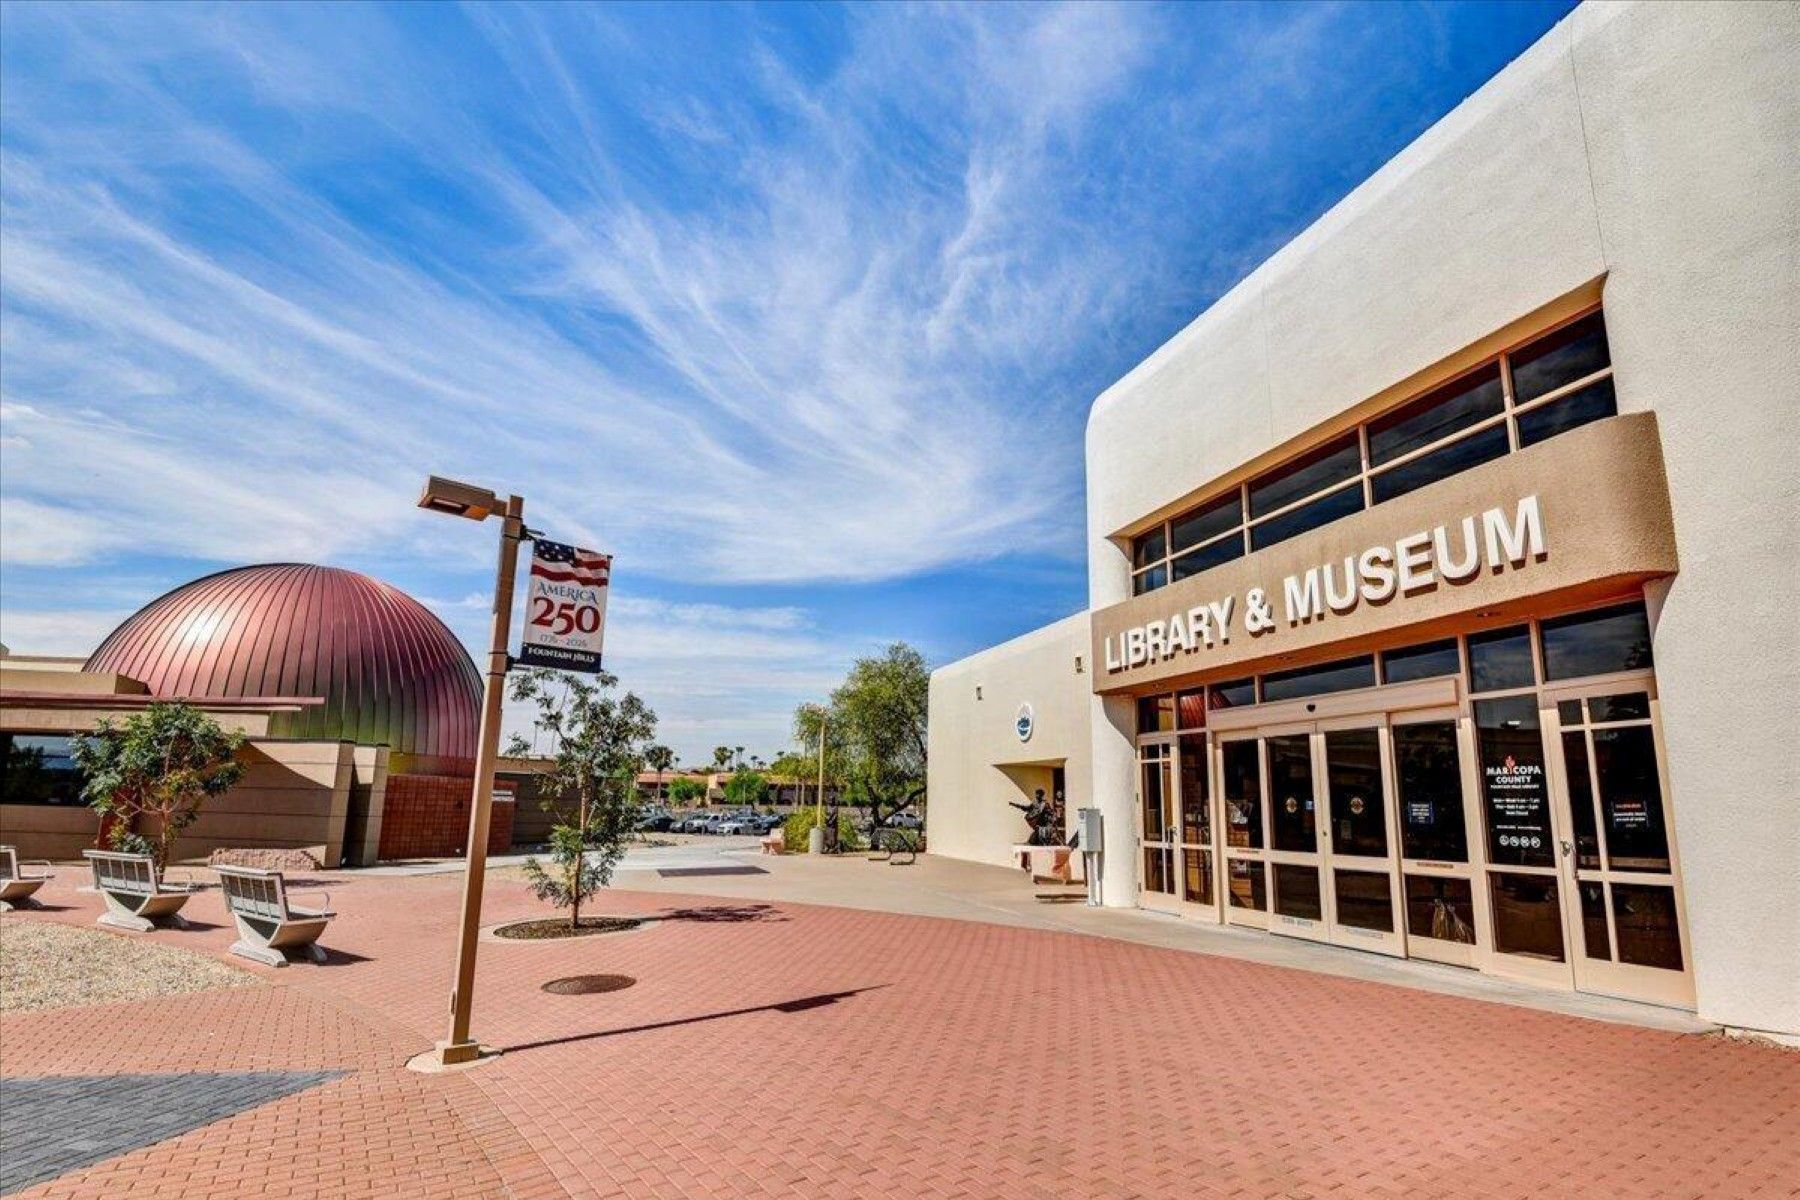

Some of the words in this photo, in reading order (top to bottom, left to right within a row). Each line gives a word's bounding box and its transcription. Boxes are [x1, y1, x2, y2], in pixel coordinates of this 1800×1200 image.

[1104, 595, 1235, 672] LIBRARY
[1244, 586, 1275, 634] &
[1284, 494, 1548, 624] MUSEUM
[537, 581, 599, 604] AMERICA
[531, 597, 601, 636] 250
[528, 647, 572, 660] FOUNTAIN
[1486, 765, 1541, 776] MARICOPA
[1495, 775, 1532, 784] COUNTY
